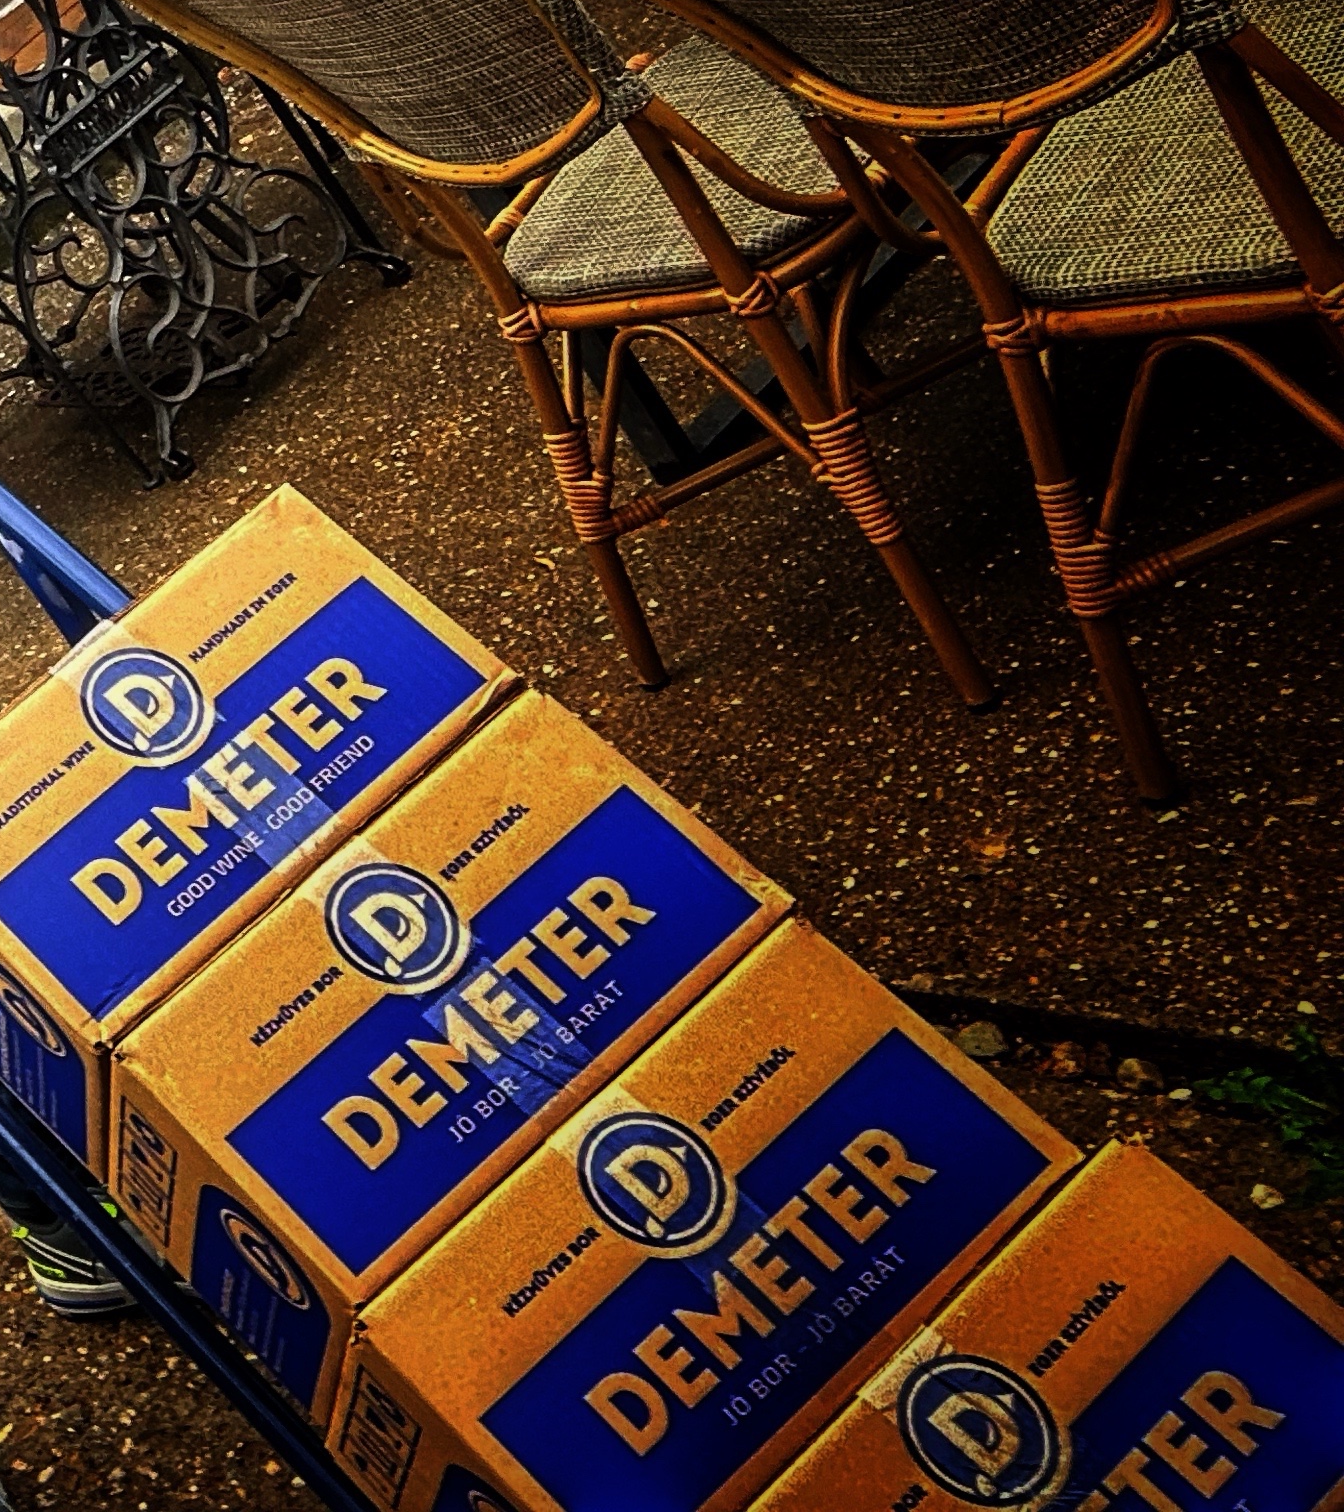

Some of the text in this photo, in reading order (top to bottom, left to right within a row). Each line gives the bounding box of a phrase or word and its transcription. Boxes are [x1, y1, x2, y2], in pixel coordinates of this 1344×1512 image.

[188, 572, 298, 664] HANDMADE IN EGER
[59, 741, 96, 774] WINE
[69, 658, 388, 926] DEMETER
[167, 735, 375, 918] GOOD WINE GOOD FRIEND
[439, 849, 475, 883] EGER
[313, 965, 345, 998] BOR
[320, 876, 657, 1171] DEMETER
[472, 1076, 521, 1120] BOR
[555, 979, 624, 1045] BARÁT
[700, 1094, 740, 1131] EGER
[566, 1226, 602, 1259] BOR
[583, 1128, 938, 1457] DEMETER
[747, 1352, 799, 1401] BOR
[831, 1245, 907, 1317] BARÁT
